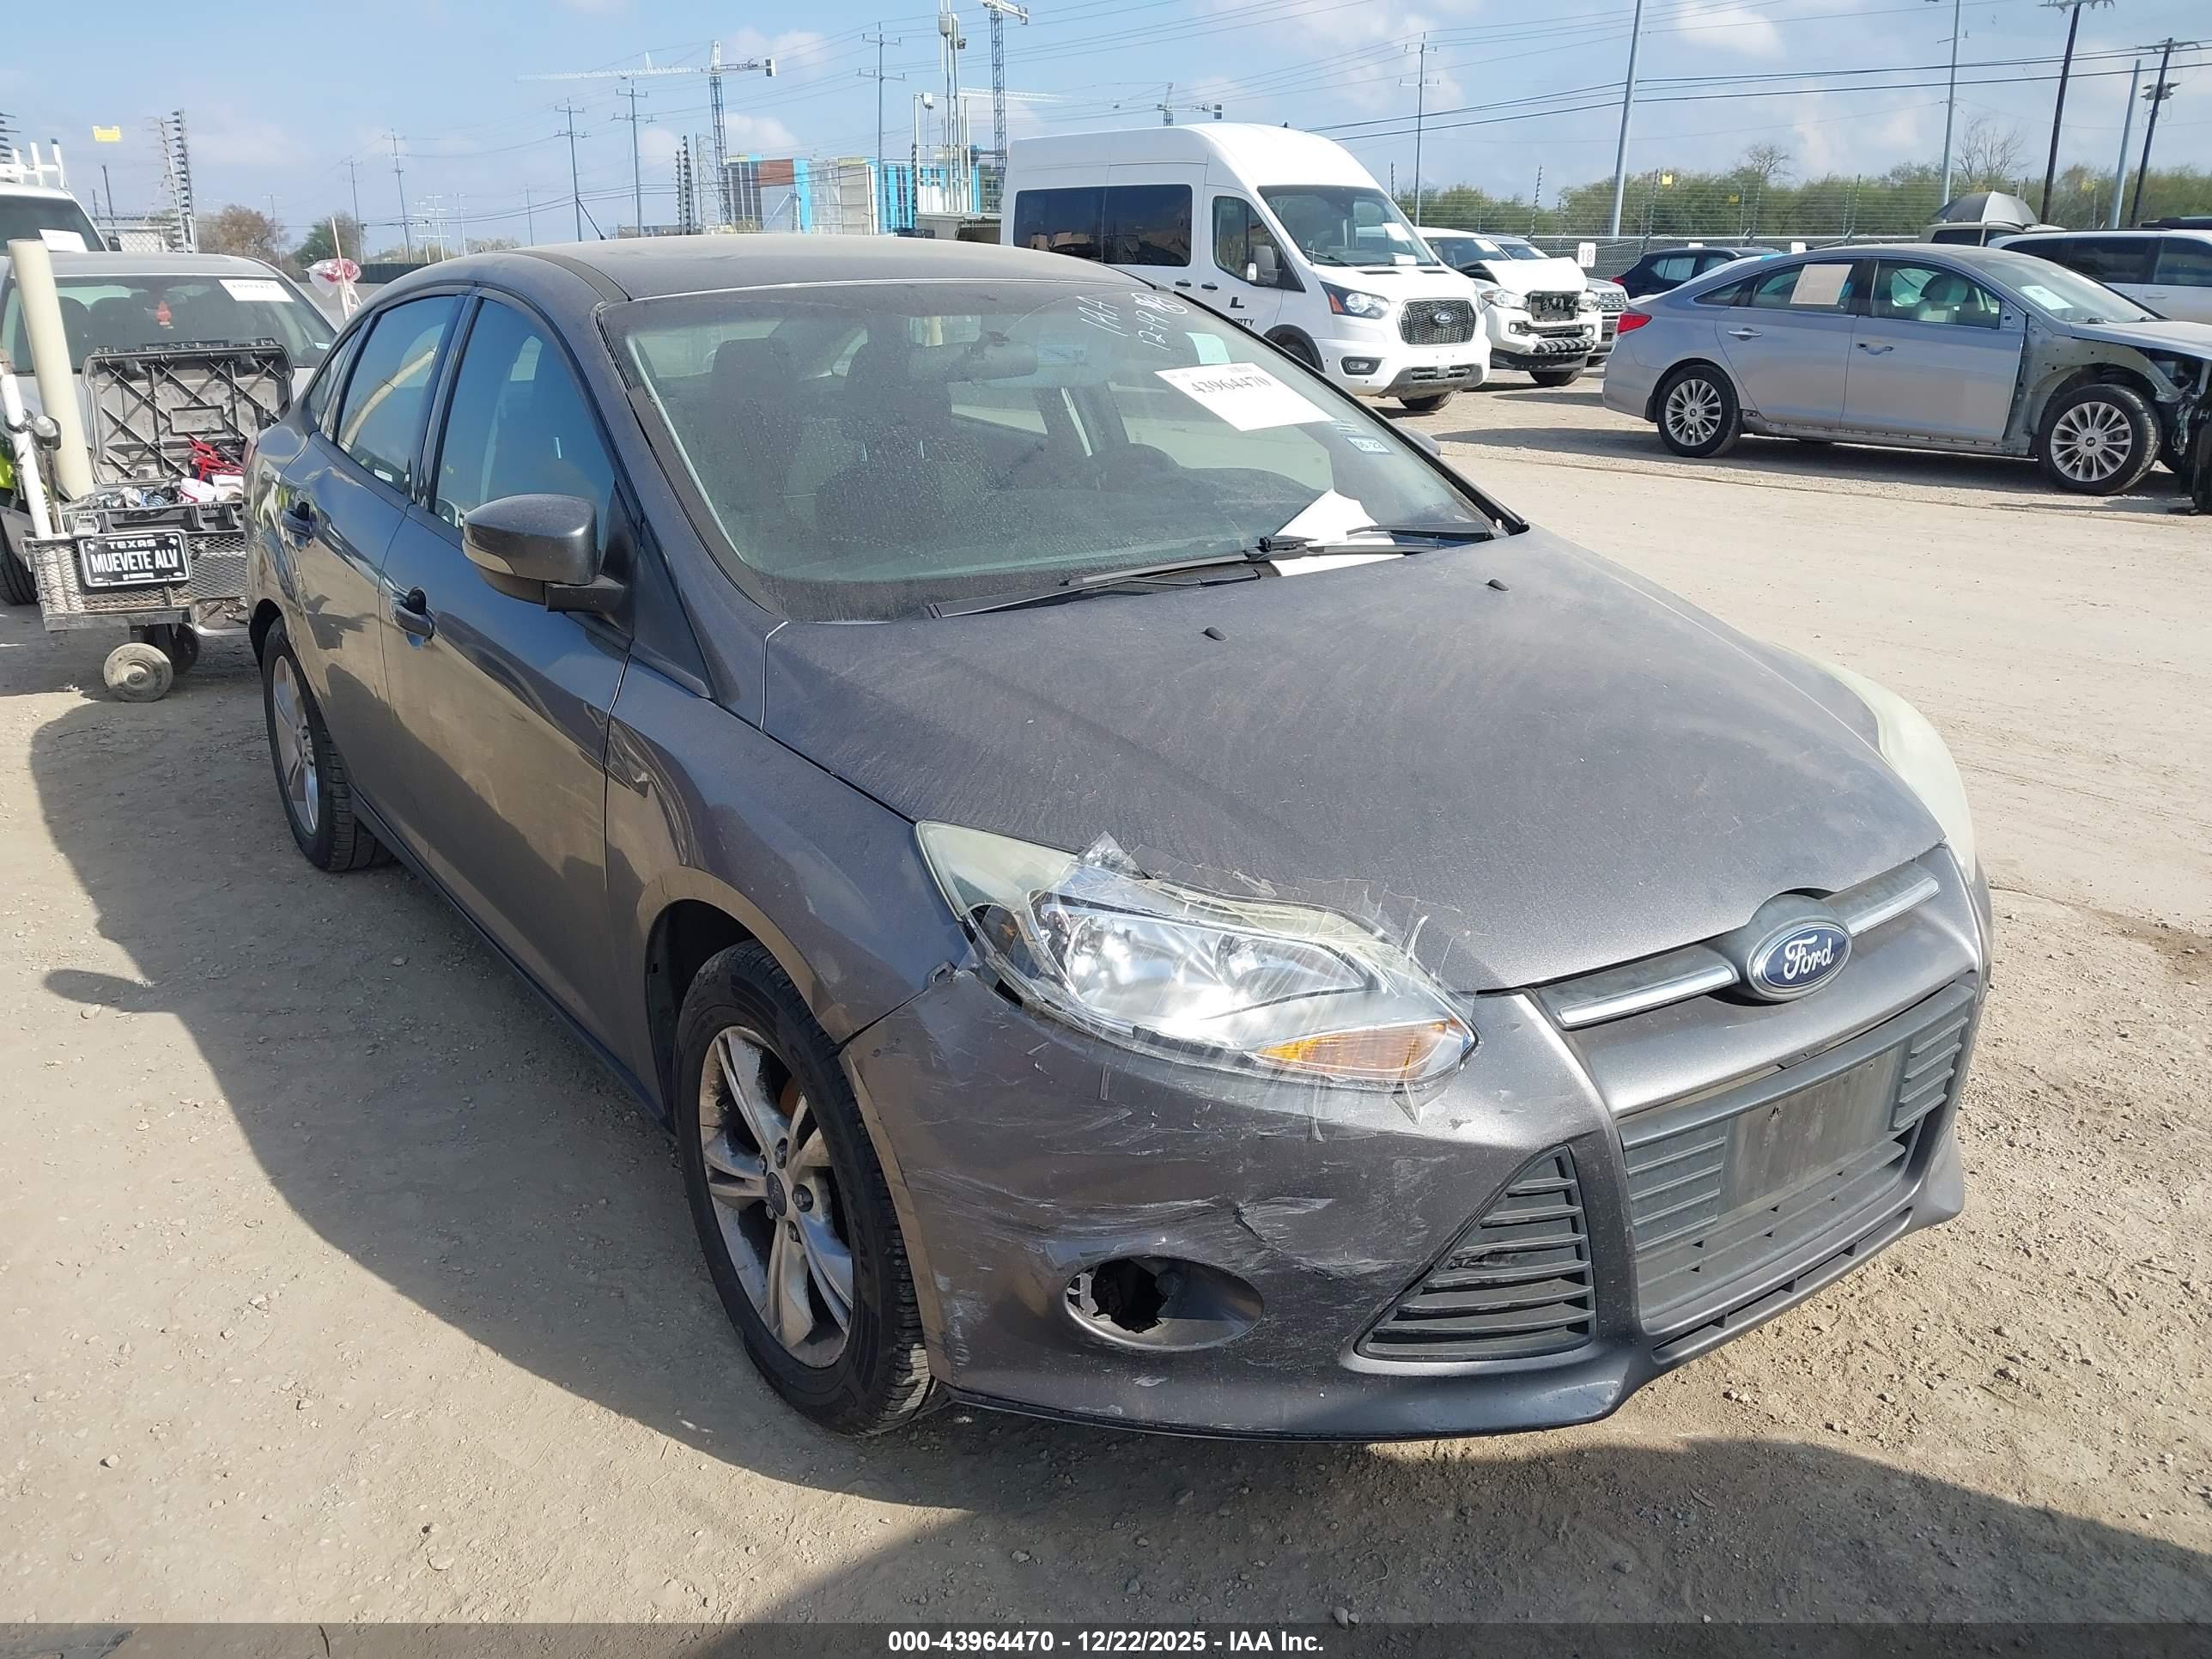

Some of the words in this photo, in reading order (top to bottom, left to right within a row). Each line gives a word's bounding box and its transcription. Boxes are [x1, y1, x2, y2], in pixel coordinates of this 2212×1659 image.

[1580, 249, 1593, 263] 18
[1191, 375, 1272, 394] 43964470
[107, 538, 157, 550] TEXAS
[90, 550, 154, 573] MUEVETE
[155, 549, 179, 568] ALV
[1784, 934, 1835, 981] Ford
